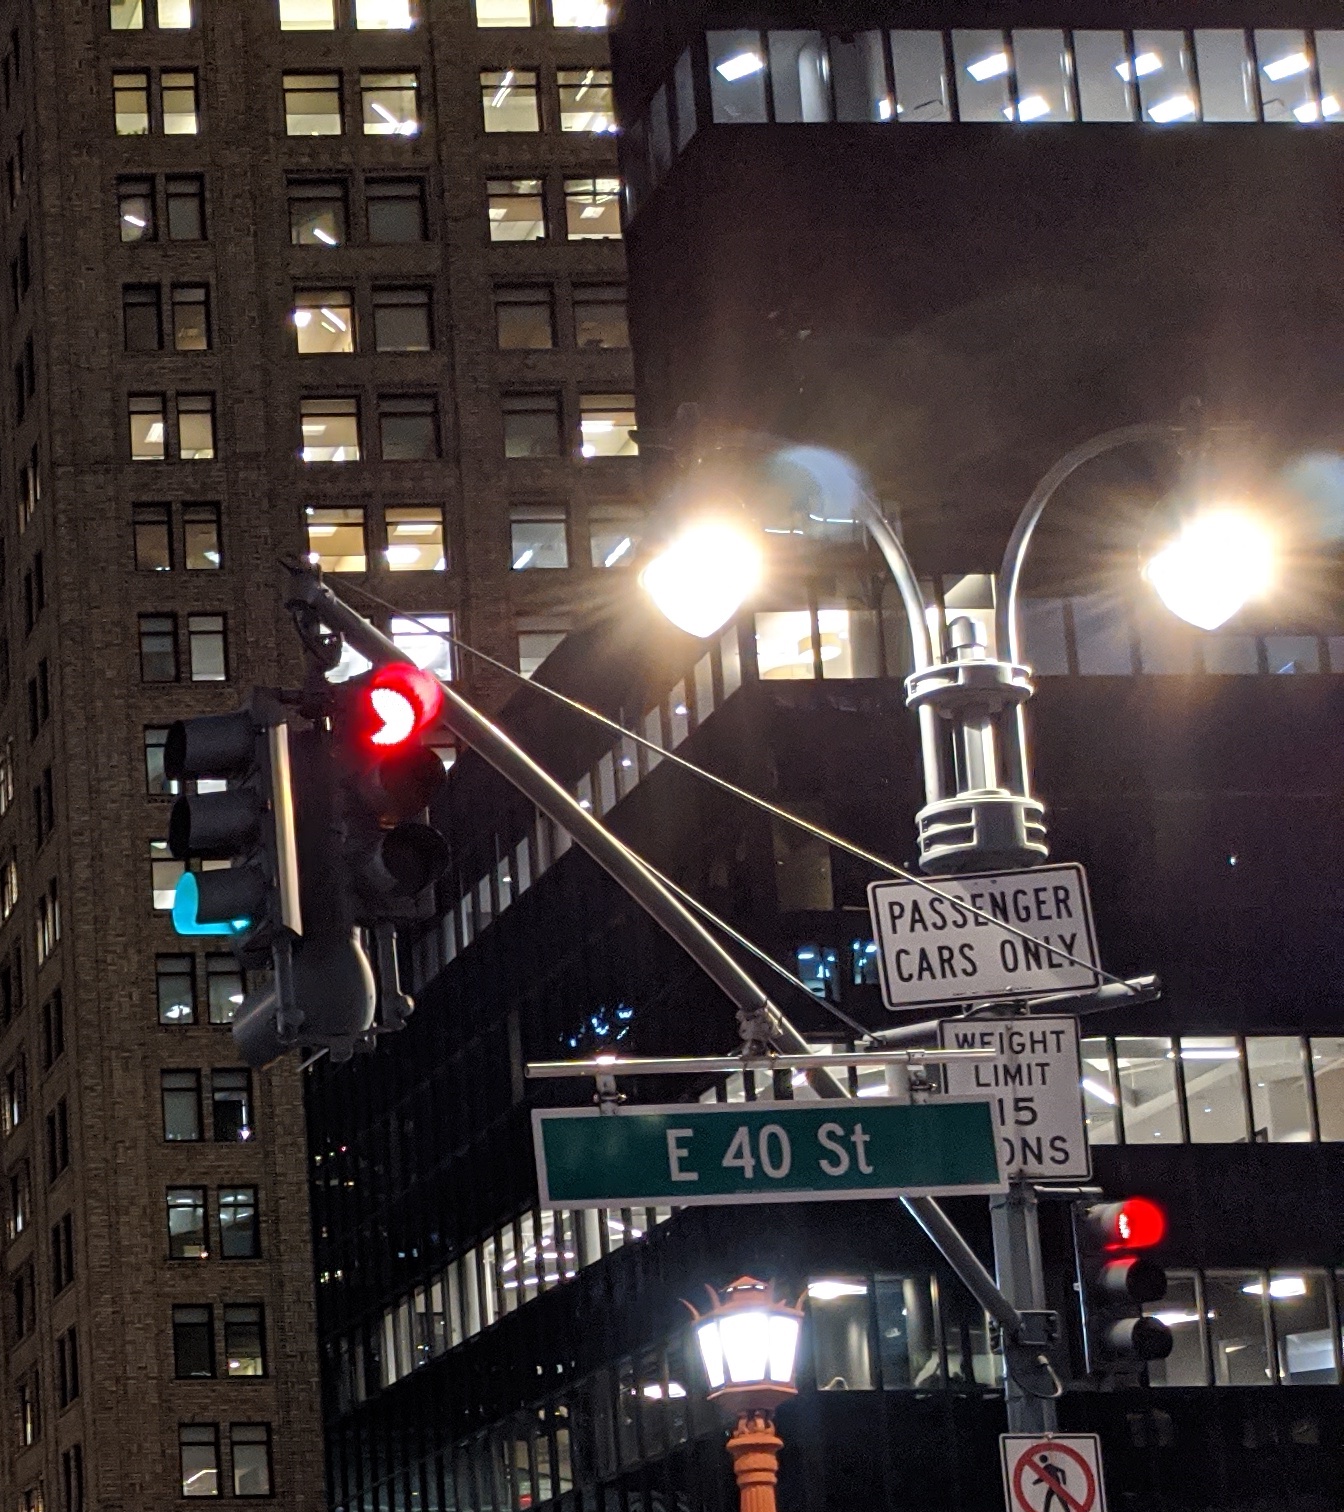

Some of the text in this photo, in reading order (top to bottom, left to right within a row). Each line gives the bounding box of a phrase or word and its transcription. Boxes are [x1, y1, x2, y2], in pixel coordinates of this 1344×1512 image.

[888, 885, 1073, 935] PASSENGER
[895, 932, 1078, 983] CARS ONLY
[955, 1030, 1065, 1055] WEIGHT
[974, 1062, 1050, 1088] LIMIT
[997, 1097, 1038, 1126] 15
[666, 1122, 874, 1182] E 40 St
